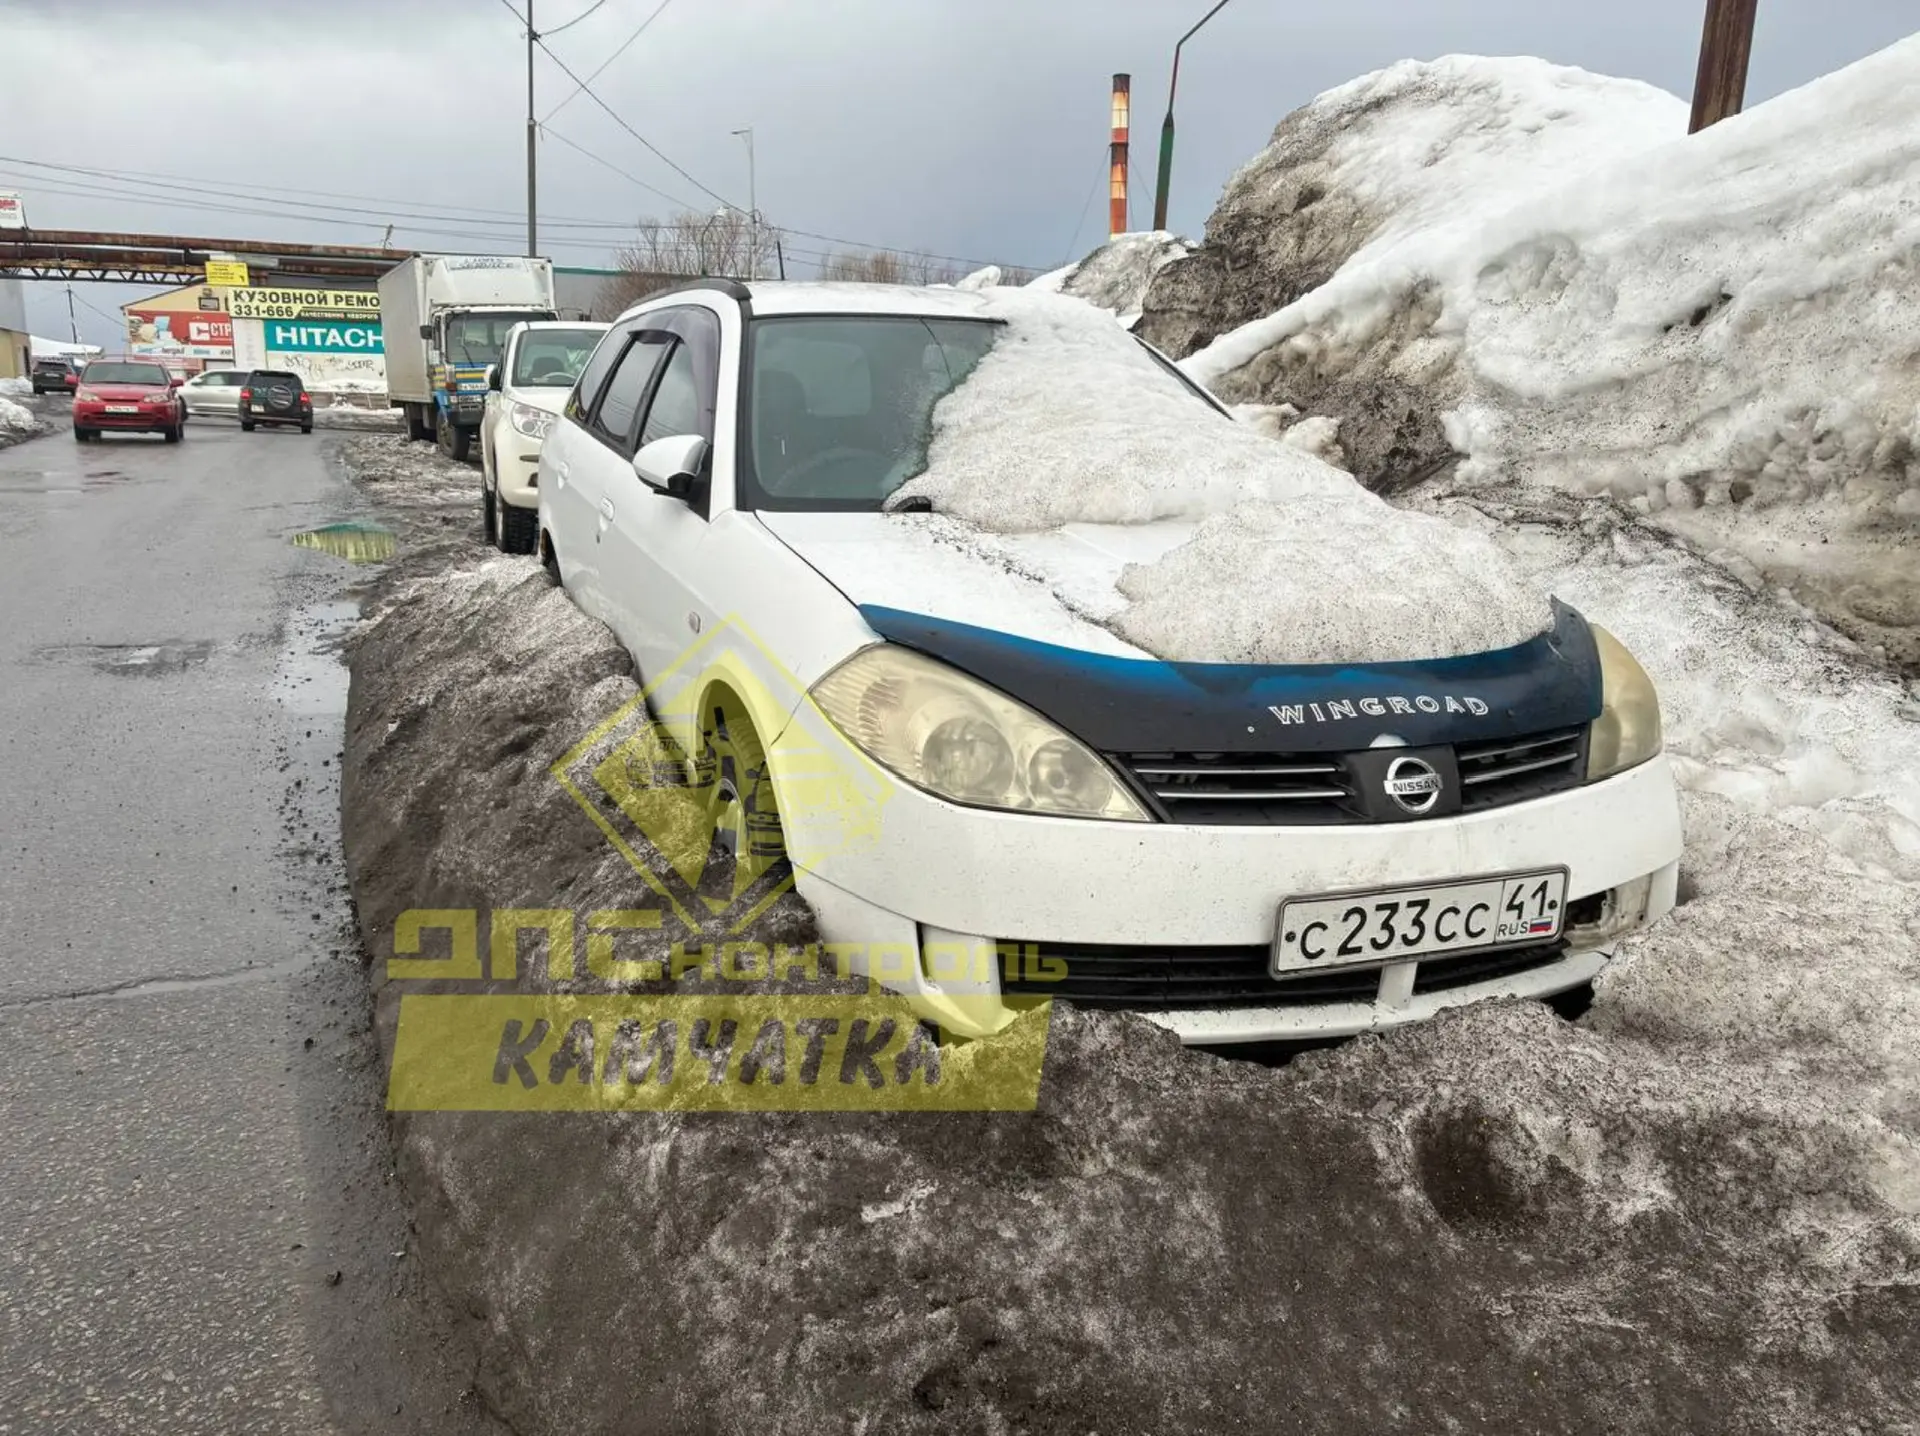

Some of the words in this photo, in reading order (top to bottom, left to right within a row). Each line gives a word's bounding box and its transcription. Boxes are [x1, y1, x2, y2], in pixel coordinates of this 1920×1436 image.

[233, 289, 328, 306] КУЗОВНОЙ
[334, 292, 380, 307] РЕМО
[234, 304, 294, 317] 331-666
[275, 325, 385, 348] HITACH
[1269, 695, 1490, 725] WINGROAD
[1392, 779, 1441, 794] NISSAN
[1505, 880, 1549, 920] 41
[1497, 921, 1530, 937] RUS
